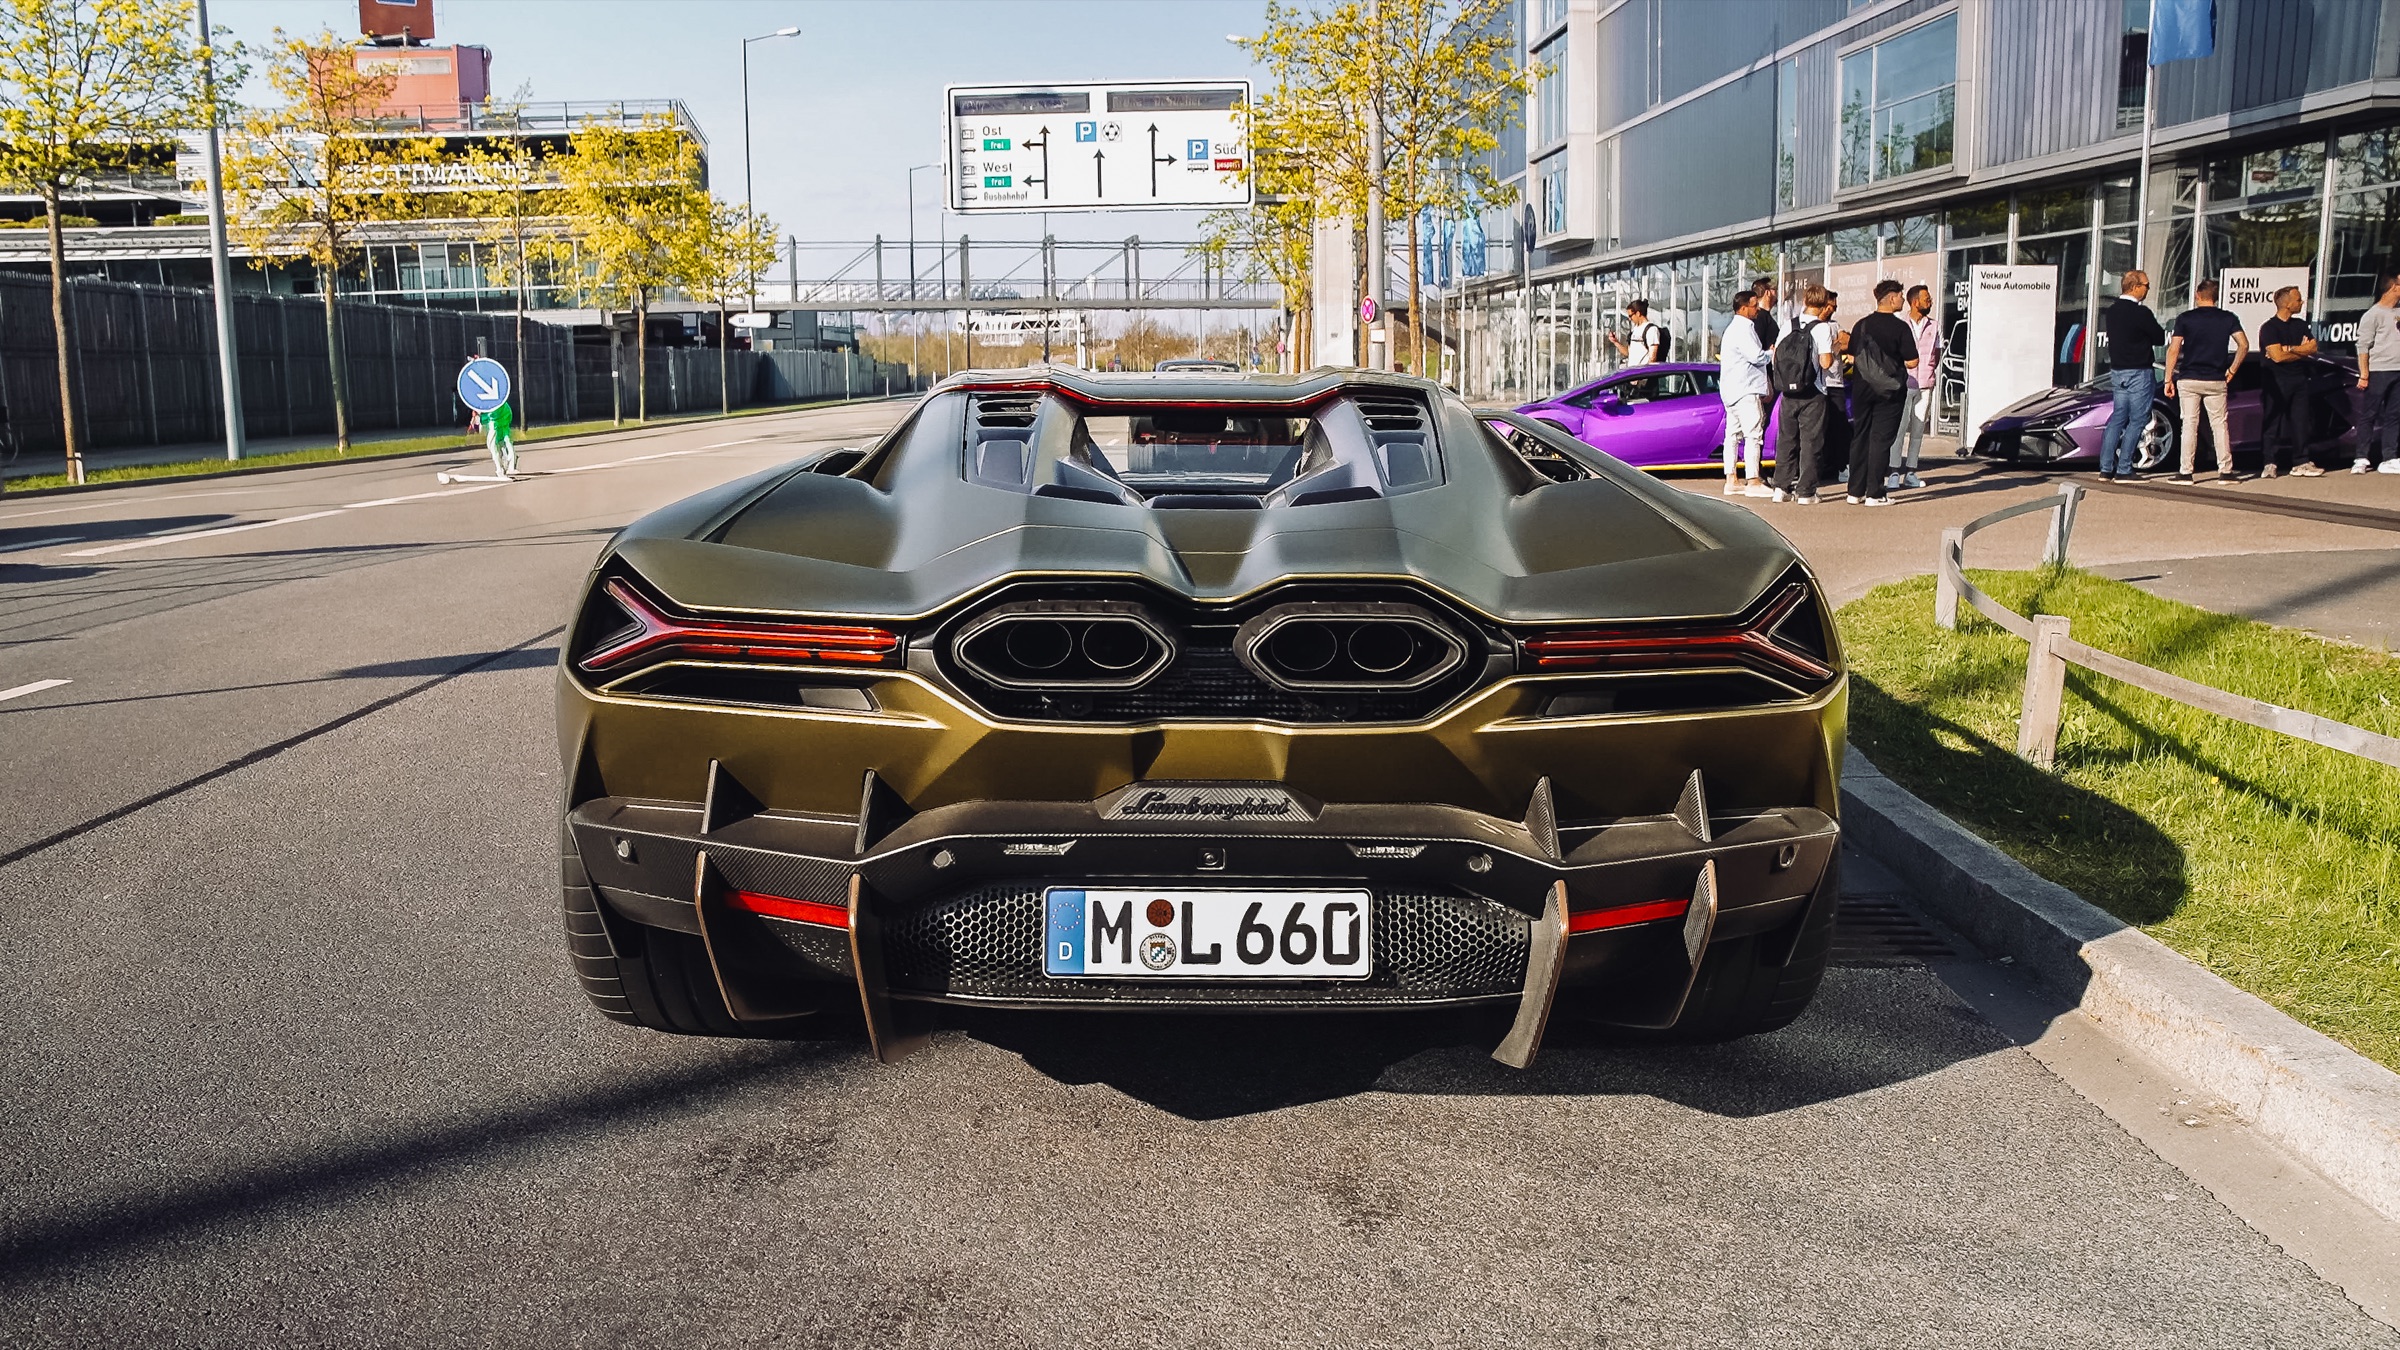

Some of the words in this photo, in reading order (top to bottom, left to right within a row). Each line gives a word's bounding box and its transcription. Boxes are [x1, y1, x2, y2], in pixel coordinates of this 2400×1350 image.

[982, 126, 1002, 136] Ost
[1214, 143, 1237, 155] Süd
[983, 162, 1012, 173] West
[983, 190, 1028, 201] Busbahnhof
[1980, 271, 2012, 280] Verkauf
[1980, 282, 2001, 290] Neue
[2003, 281, 2051, 290] Automobile
[2230, 278, 2260, 289] MINI
[2229, 291, 2274, 304] SERVIC
[2317, 322, 2359, 342] WORL
[1122, 791, 1291, 820] Lamborghini
[1058, 941, 1073, 961] D
[1092, 900, 1132, 965] M
[1181, 901, 1222, 965] L
[1236, 901, 1361, 966] 660
